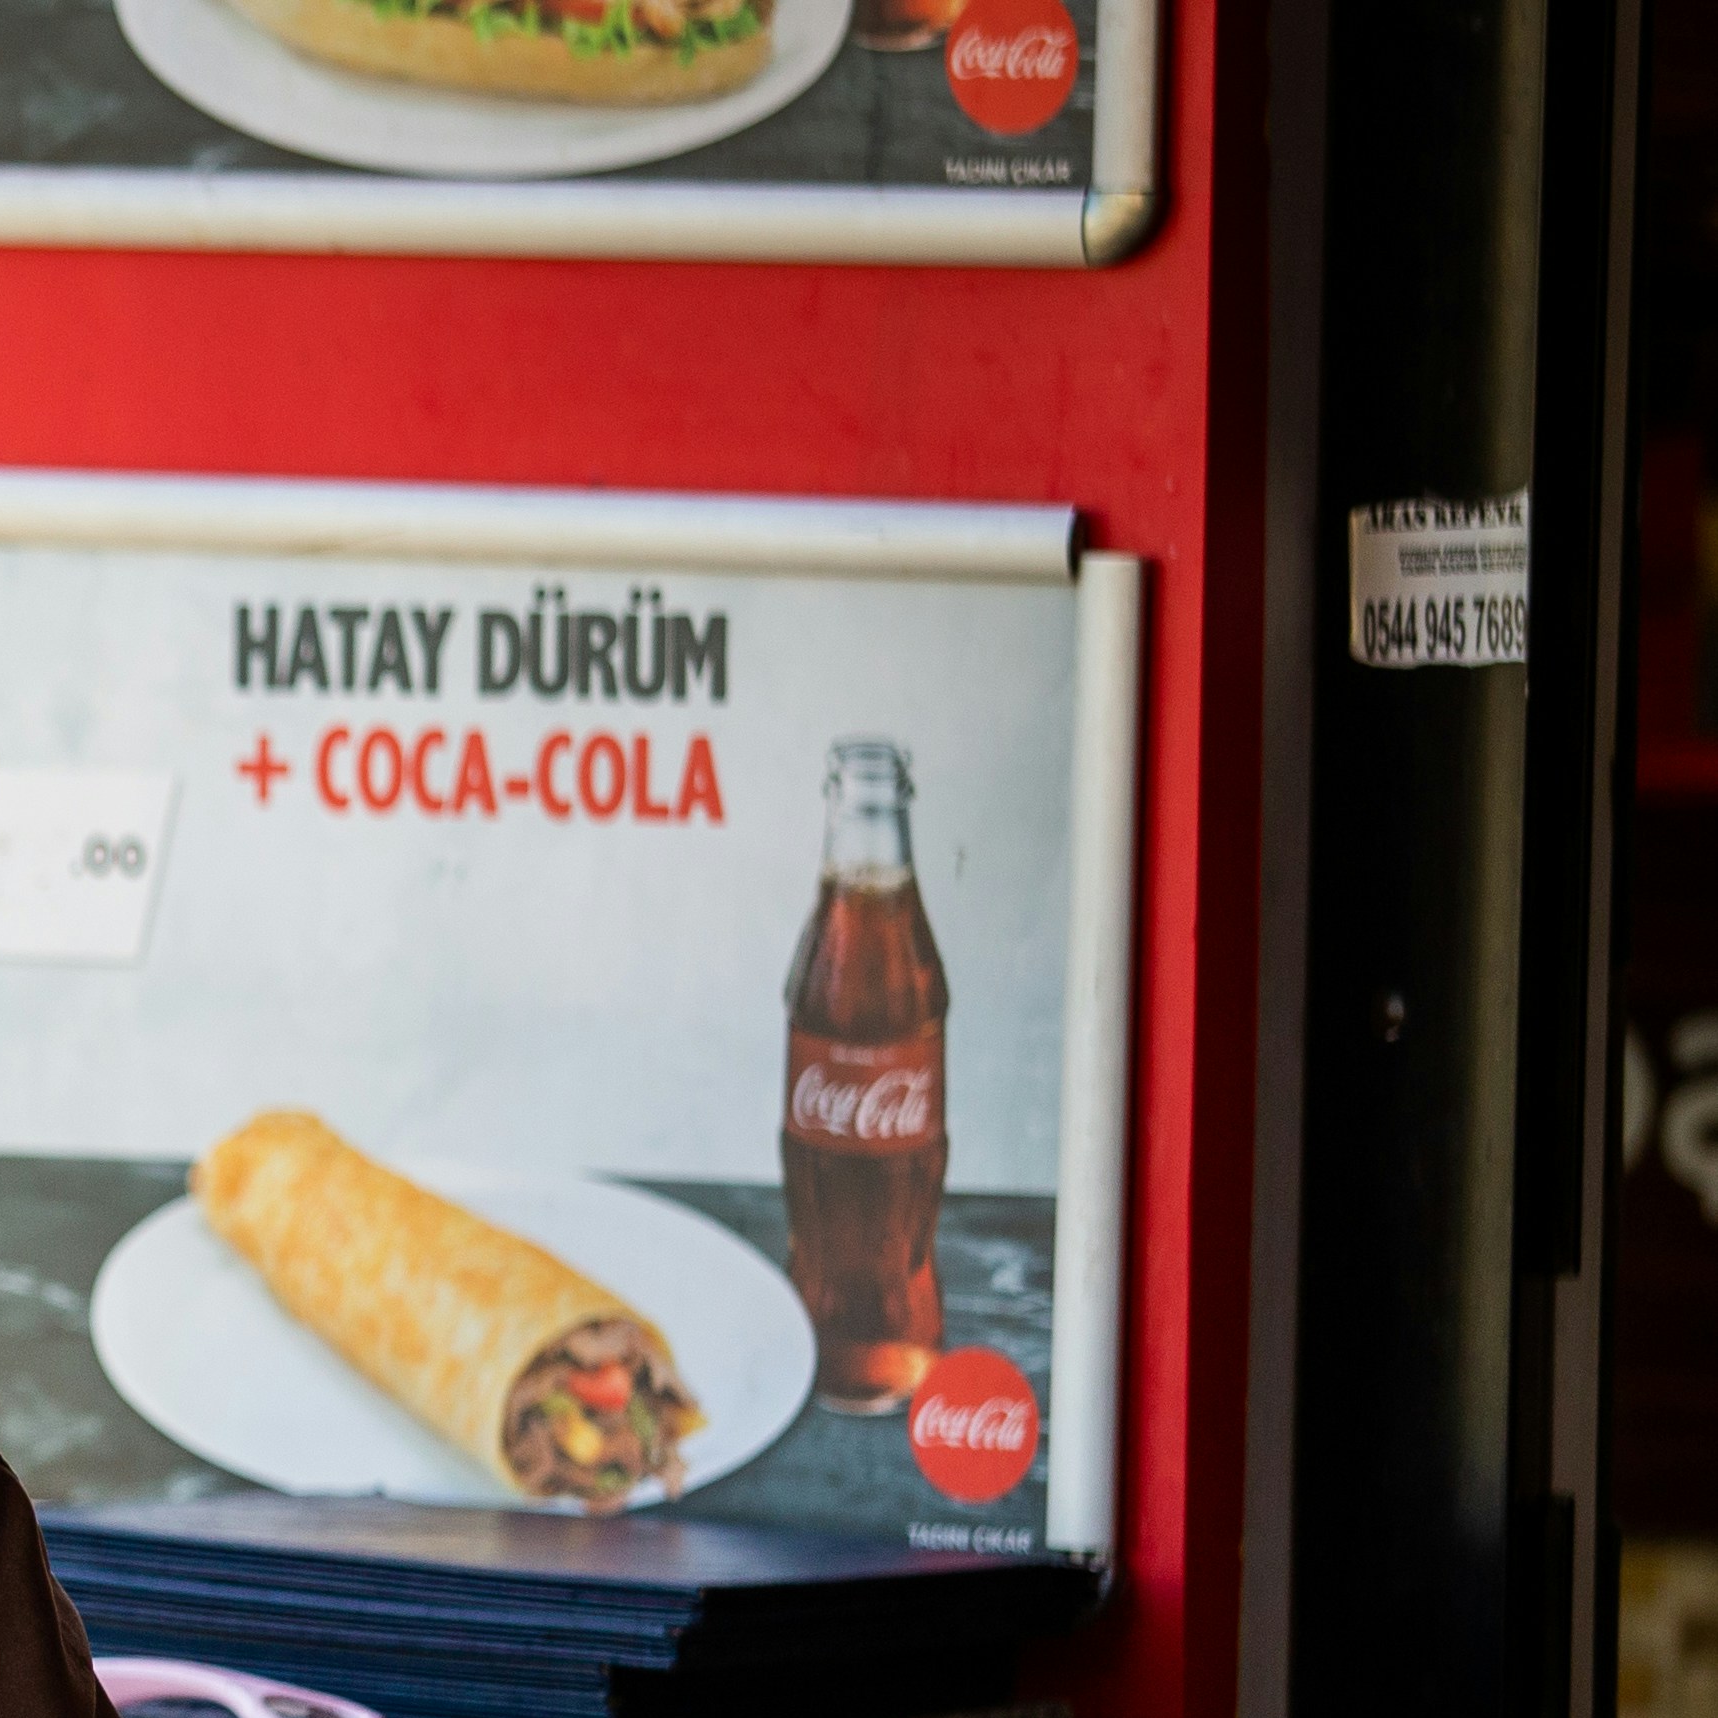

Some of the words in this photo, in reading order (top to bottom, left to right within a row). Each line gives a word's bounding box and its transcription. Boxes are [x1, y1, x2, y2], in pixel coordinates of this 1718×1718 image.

[235, 604, 455, 694] HATAY
[477, 587, 729, 702] DÜRÜM
[1364, 597, 1417, 660] 0544
[1425, 594, 1466, 658] 945
[1474, 594, 1526, 657] 7689
[237, 732, 288, 804] +
[314, 724, 727, 826] COCA-COLA
